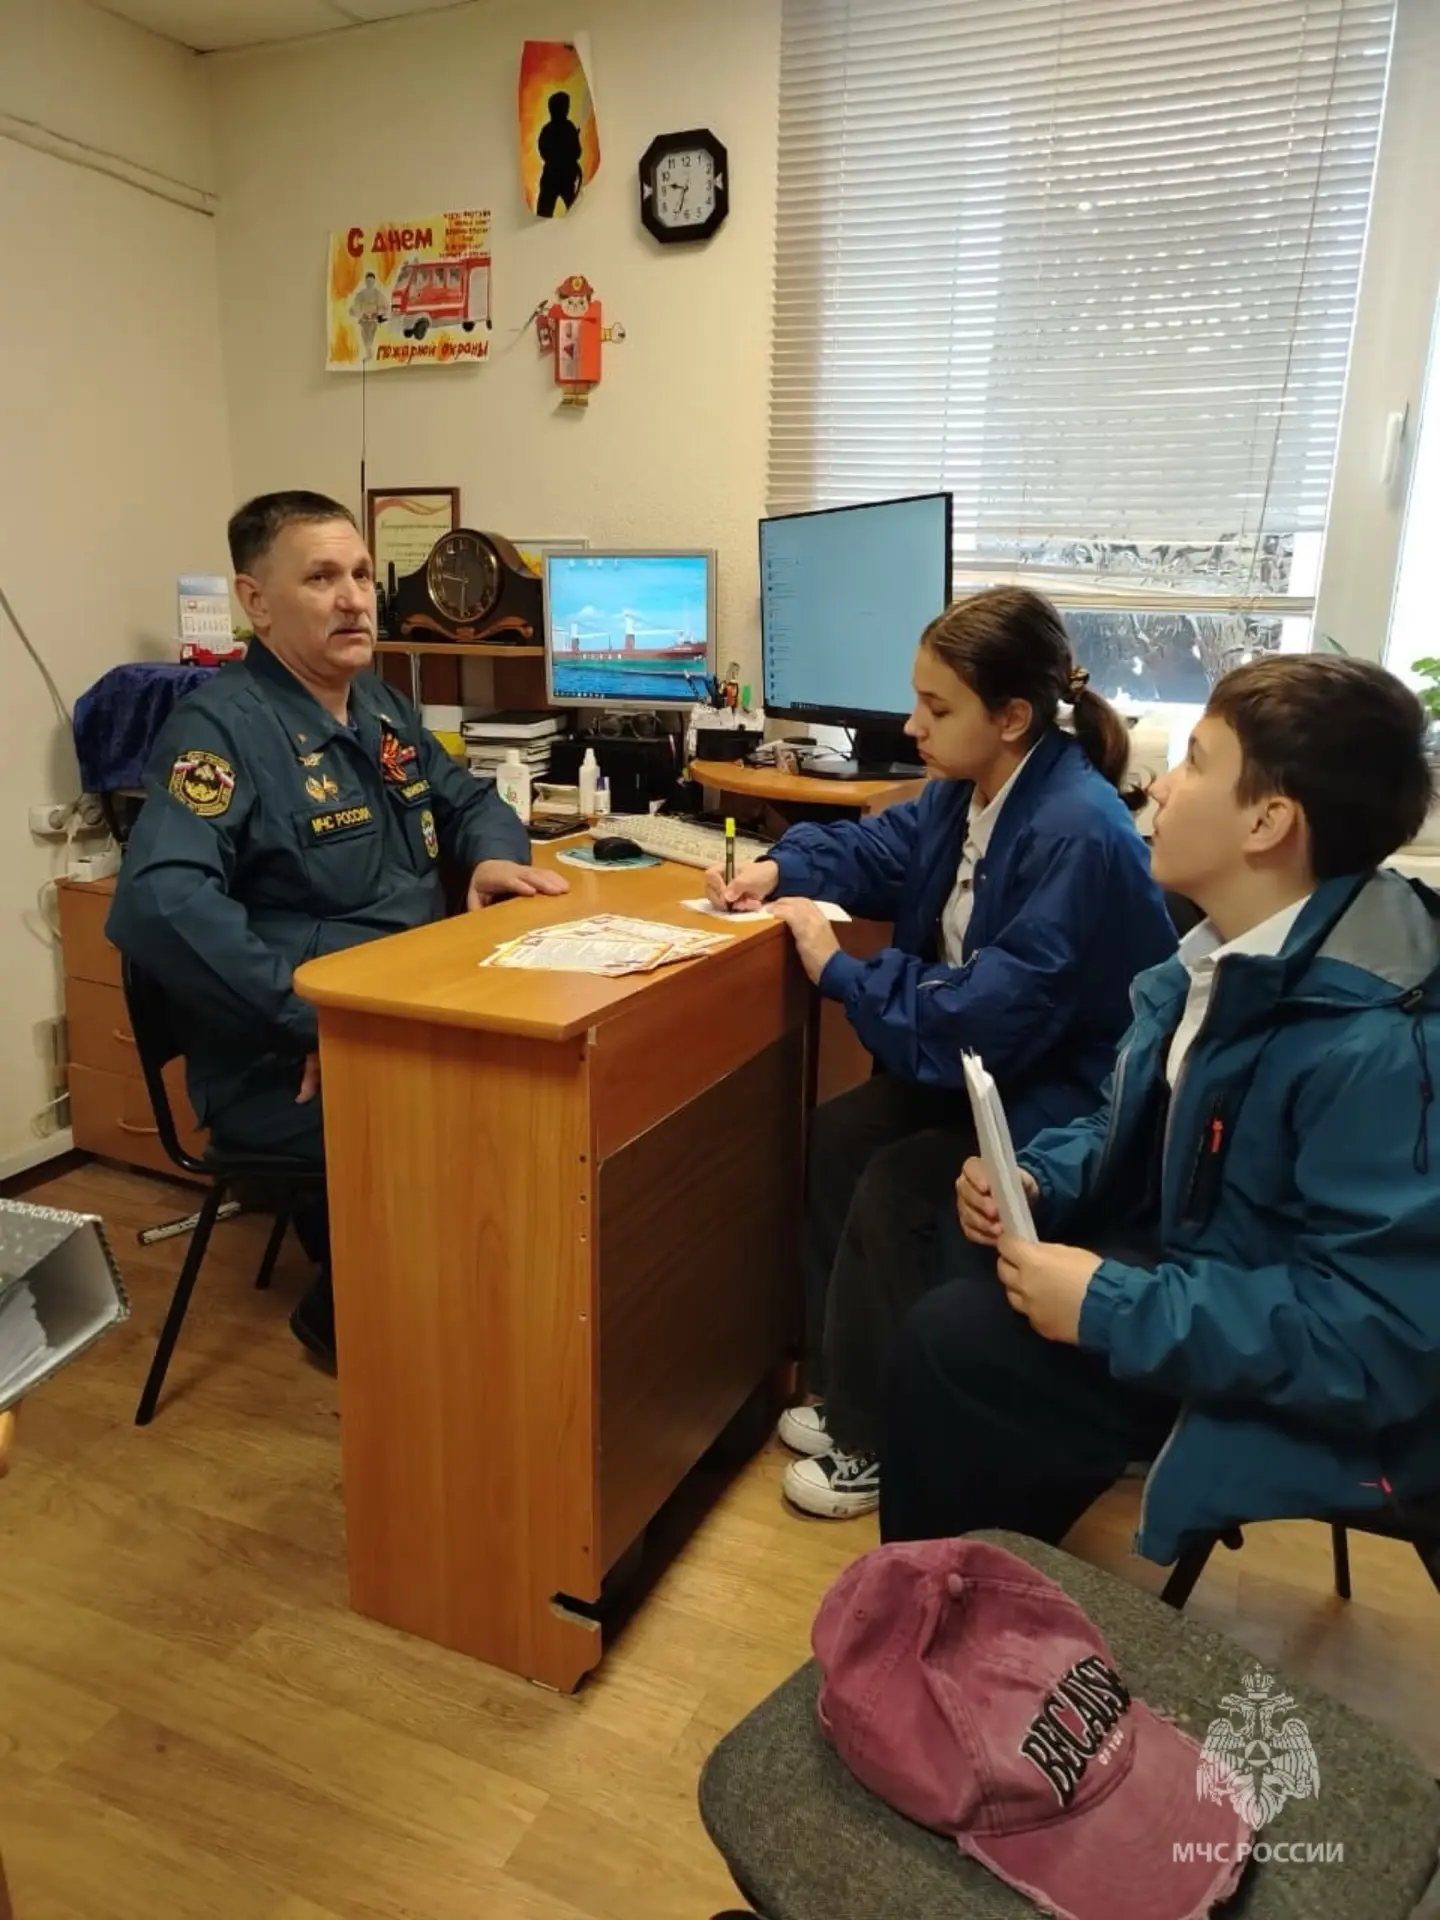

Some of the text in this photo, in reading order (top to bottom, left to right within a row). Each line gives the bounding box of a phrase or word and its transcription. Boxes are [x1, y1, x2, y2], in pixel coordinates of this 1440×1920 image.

[347, 228, 364, 257] С
[312, 807, 371, 833] МЧС РОССИИ
